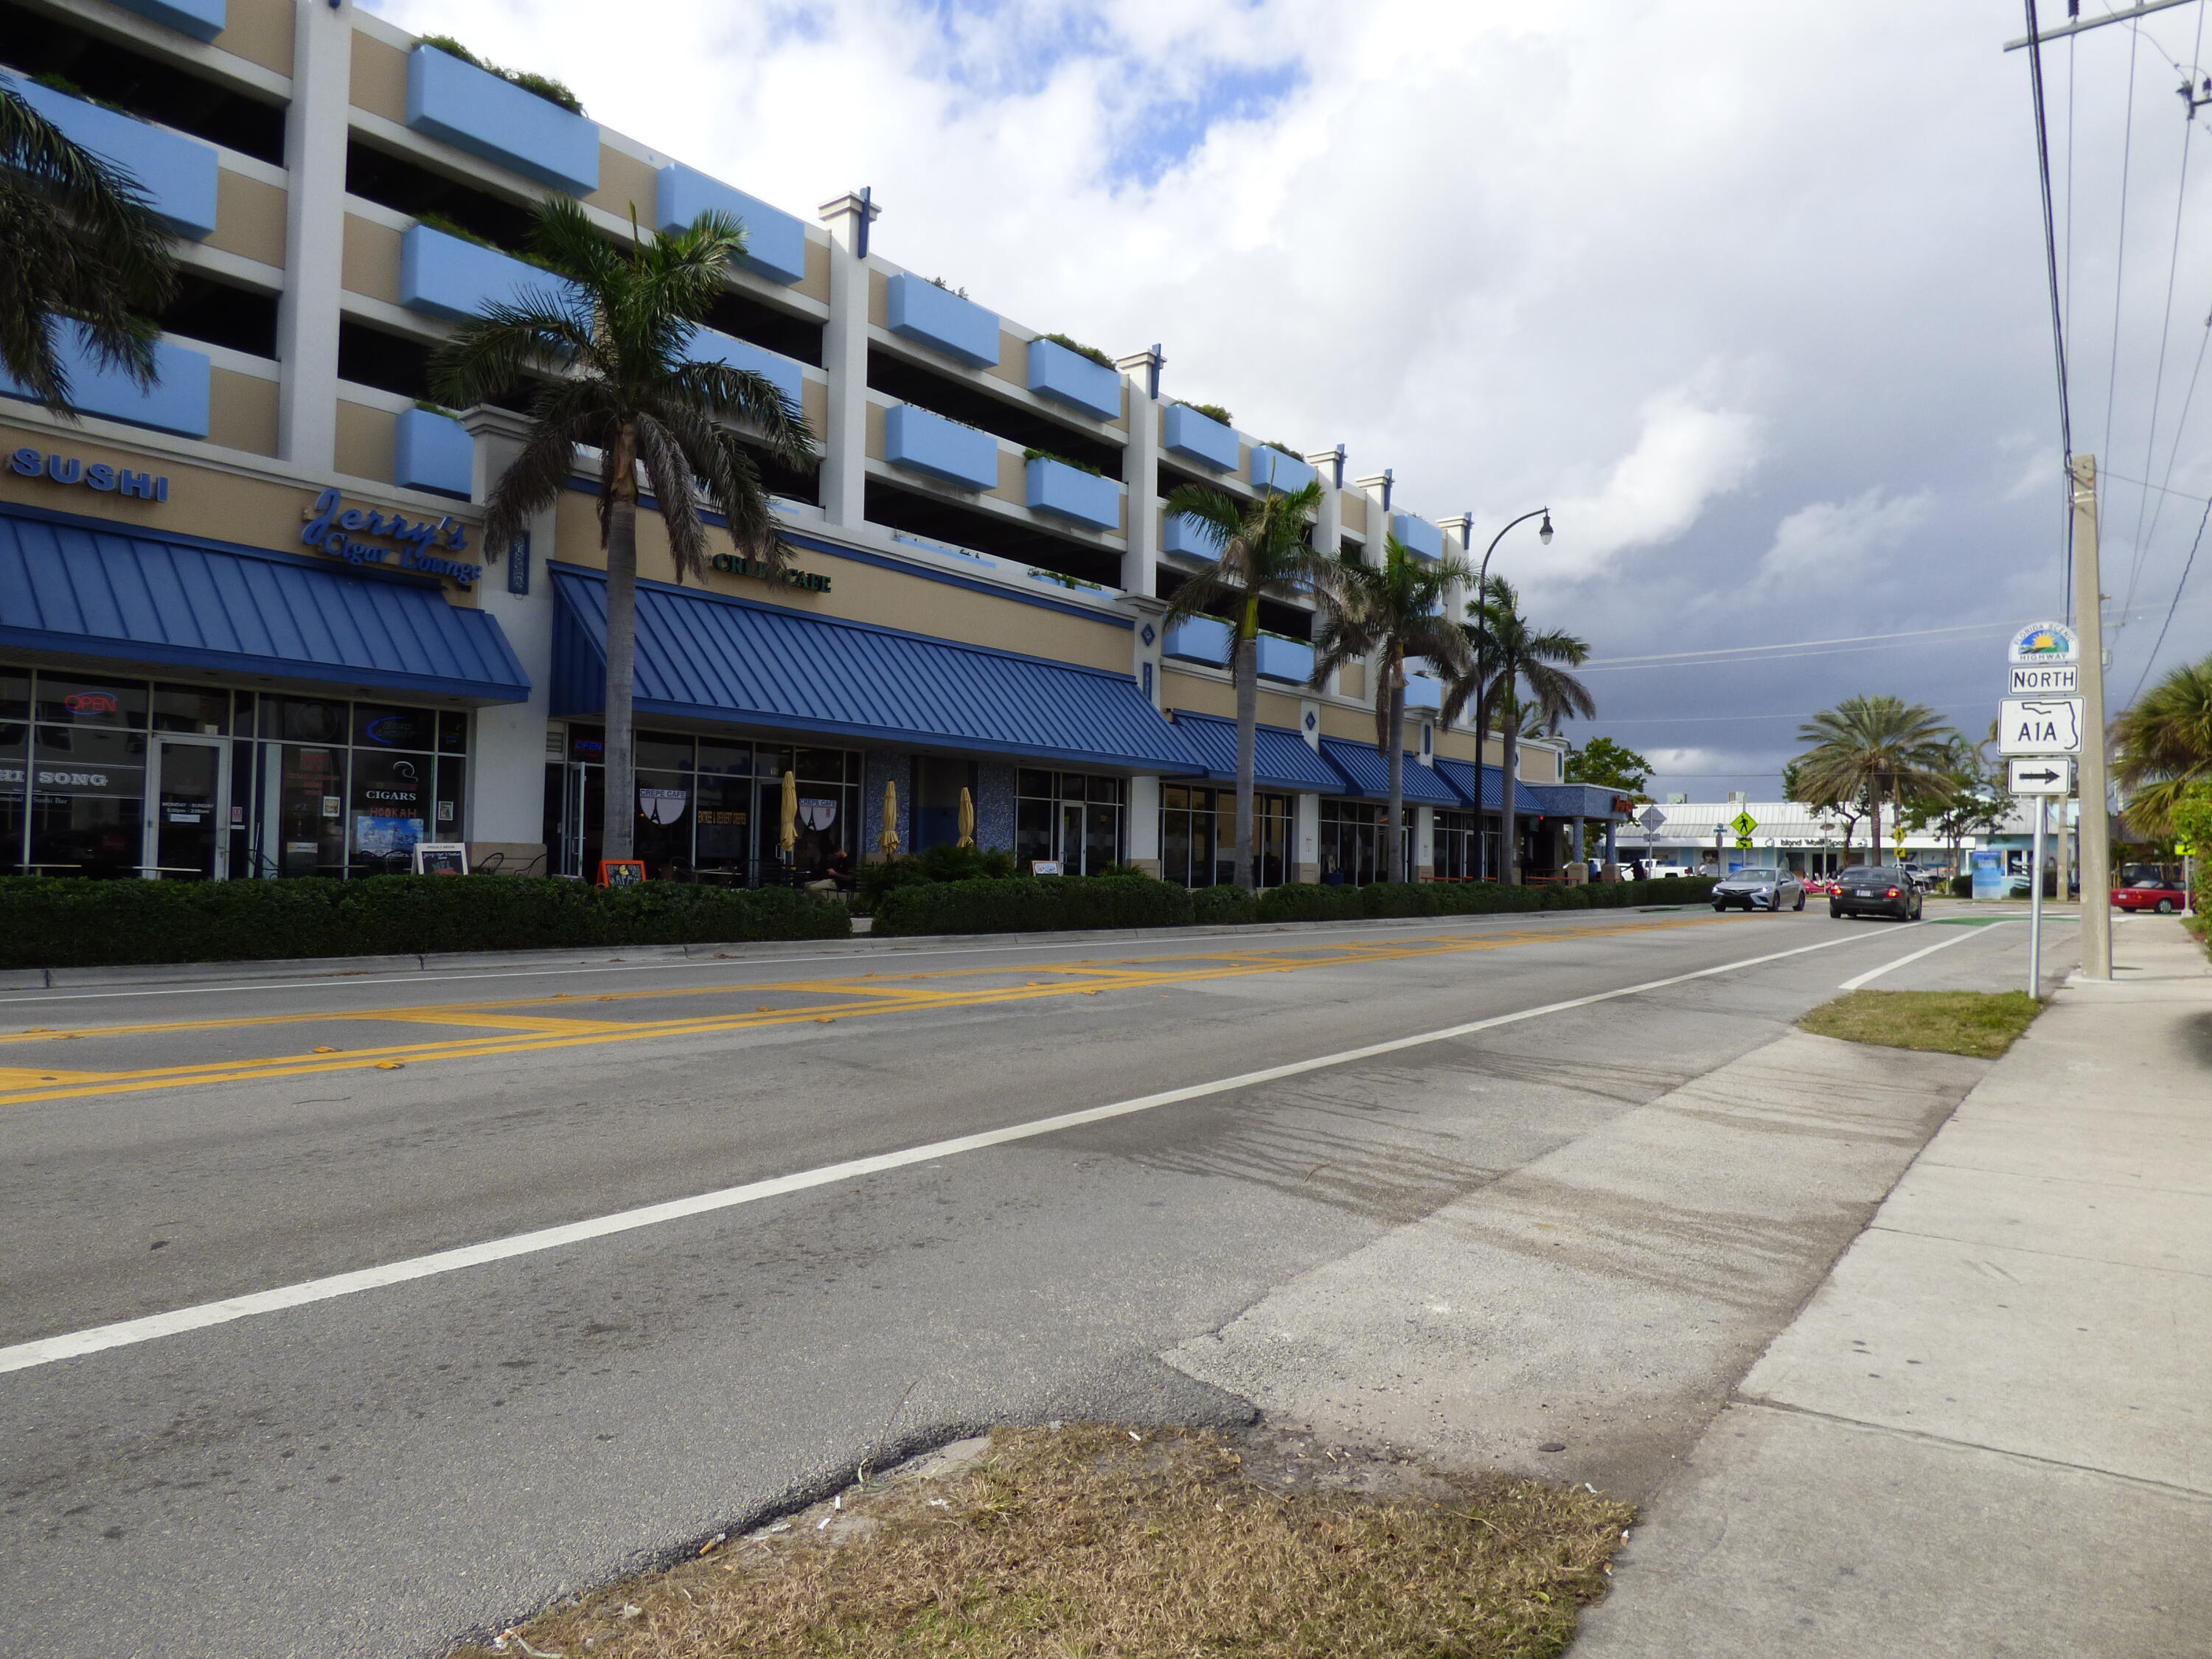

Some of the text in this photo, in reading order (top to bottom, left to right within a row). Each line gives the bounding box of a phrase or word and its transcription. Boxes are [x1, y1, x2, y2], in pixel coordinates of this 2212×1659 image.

[10, 448, 170, 504] SUSHI
[302, 487, 468, 558] Jerry's
[324, 532, 392, 565] Cigar
[398, 545, 483, 584] Lounge
[785, 568, 832, 593] CAFE
[2014, 624, 2075, 645] FLORIDA SCENIC
[2020, 653, 2067, 661] HIGHWAY
[2014, 671, 2074, 688] NORTH
[65, 694, 118, 712] OPEN
[2017, 721, 2057, 742] A1A
[575, 740, 602, 751] OPEN
[38, 771, 108, 787] SONG
[32, 796, 53, 804] Sushi
[366, 790, 417, 801] CIGARS
[640, 789, 686, 798] CREPE CAFE
[370, 807, 417, 818] HOOKAH
